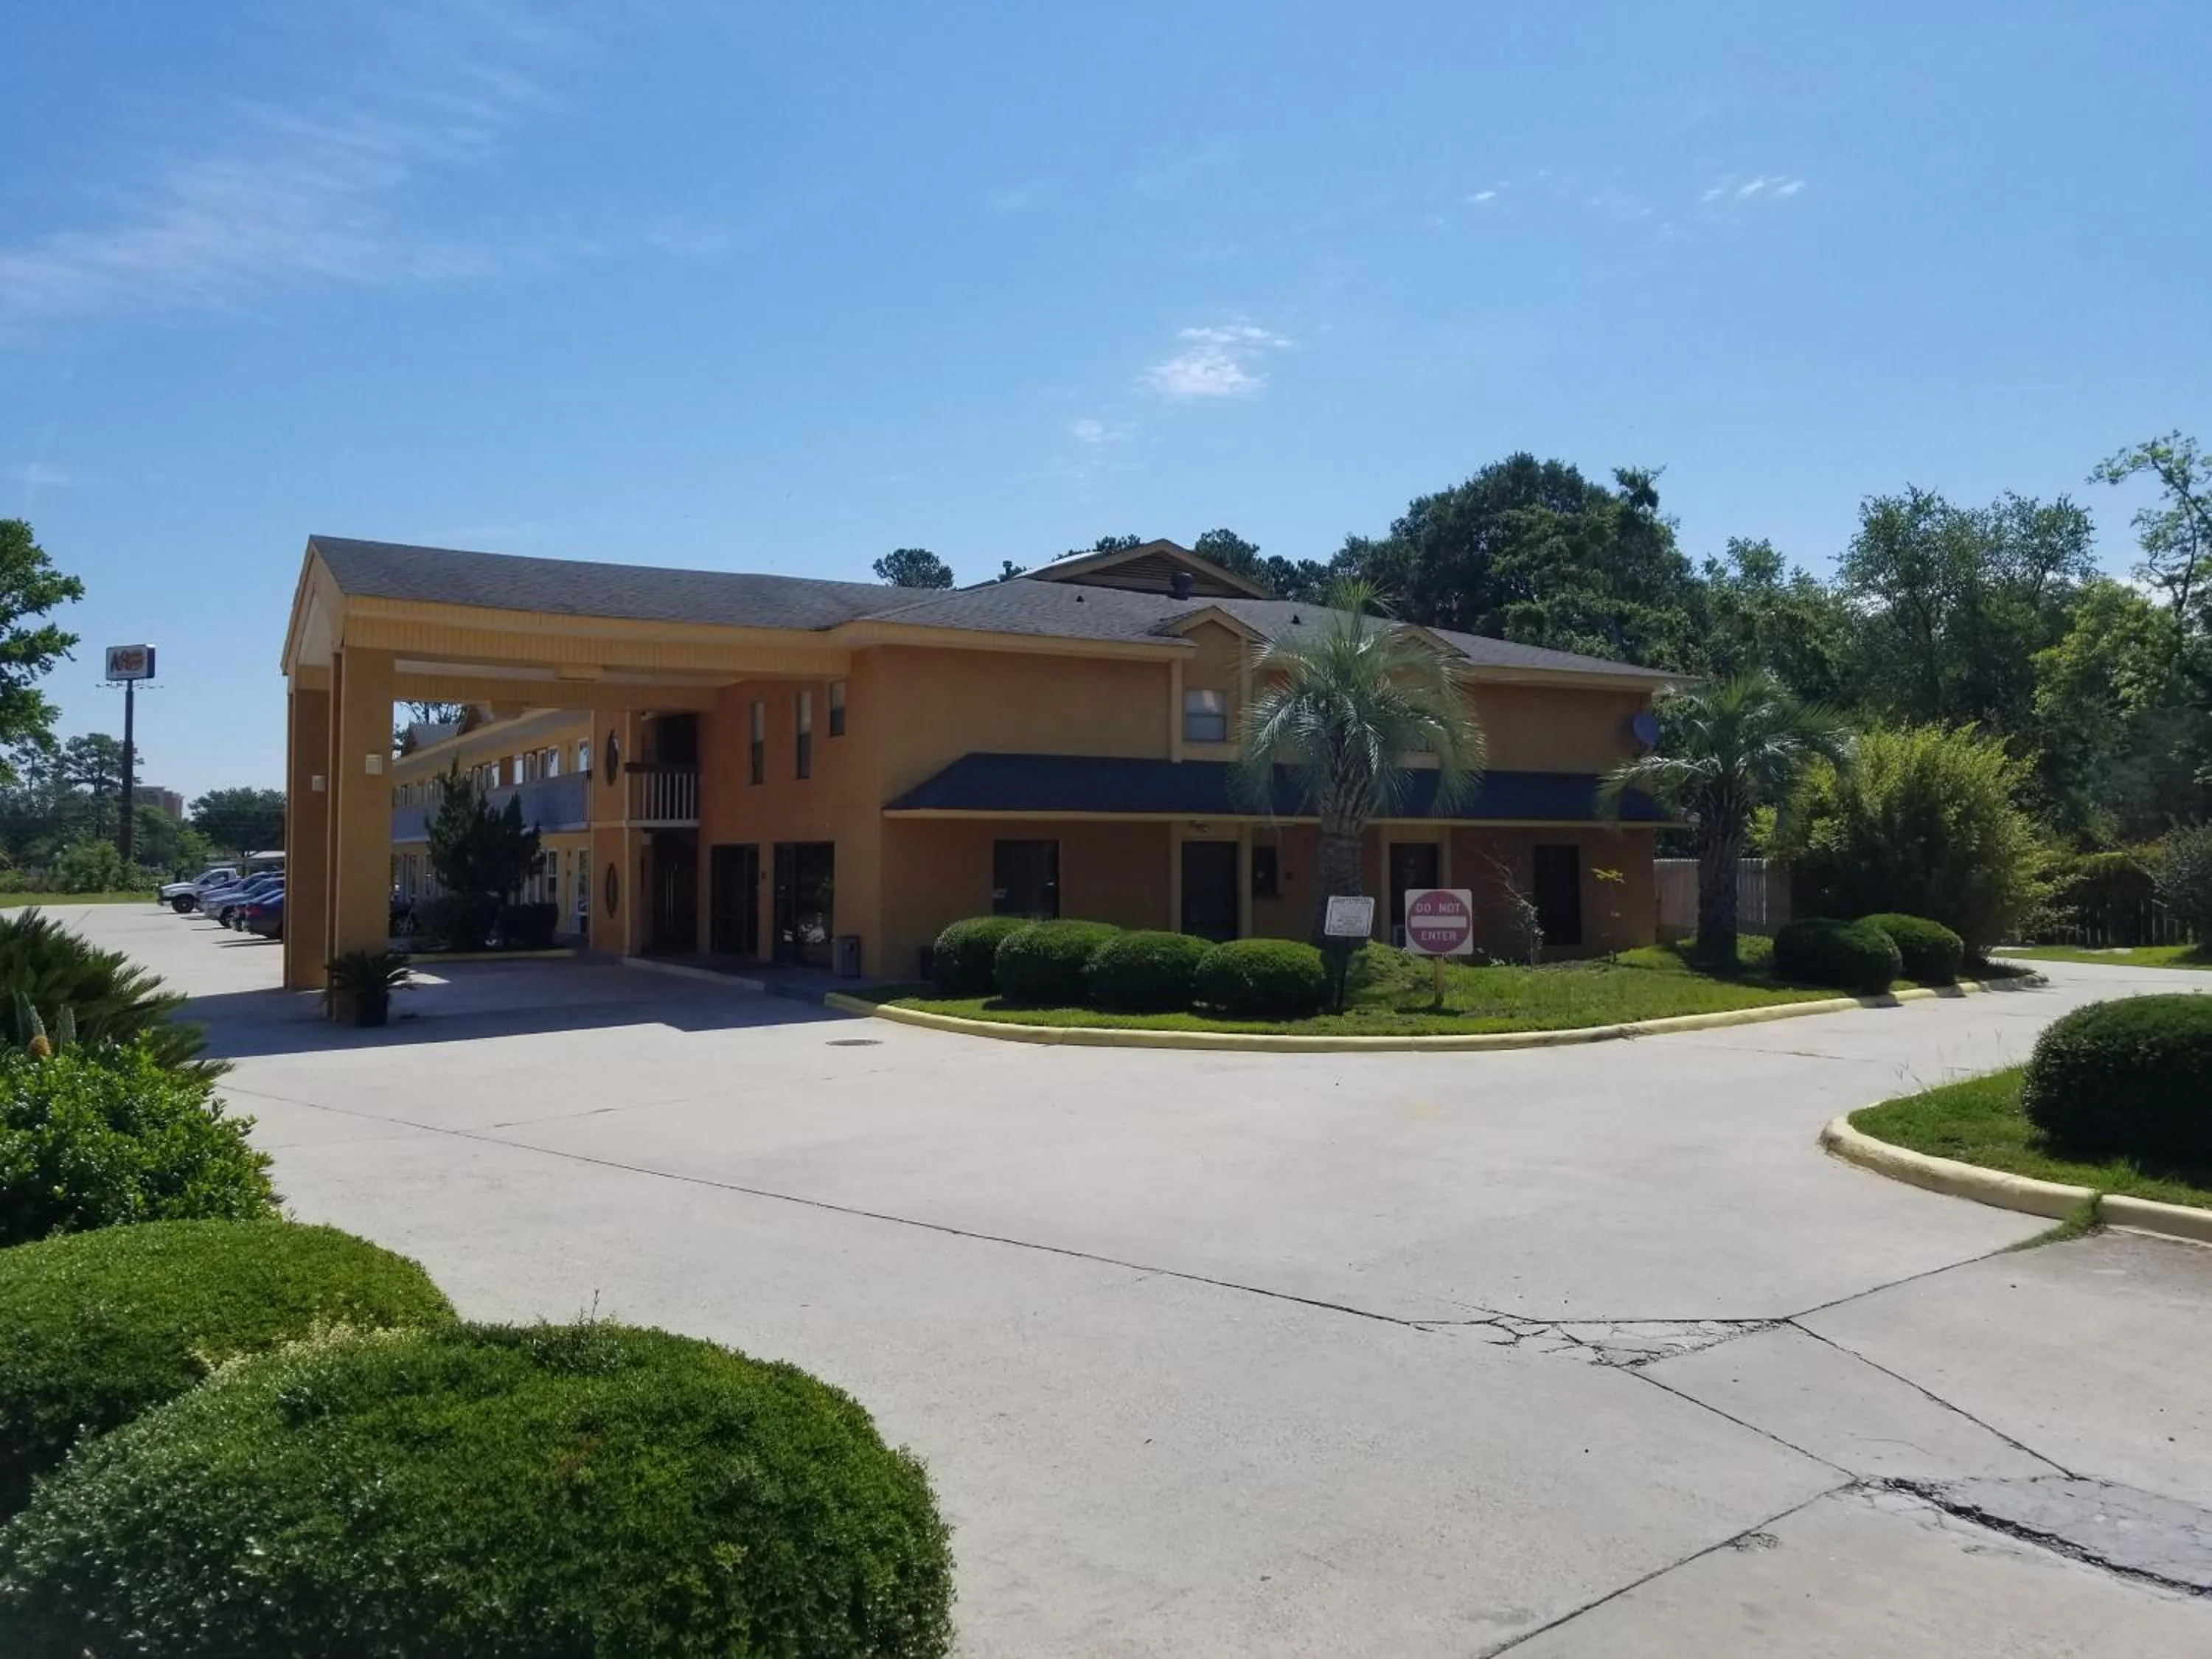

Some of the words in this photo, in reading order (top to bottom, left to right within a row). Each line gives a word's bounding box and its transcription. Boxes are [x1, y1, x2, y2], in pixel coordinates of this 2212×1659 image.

[1416, 902, 1431, 913] DO
[1439, 902, 1461, 913] NOT
[1421, 931, 1457, 942] ENTER
